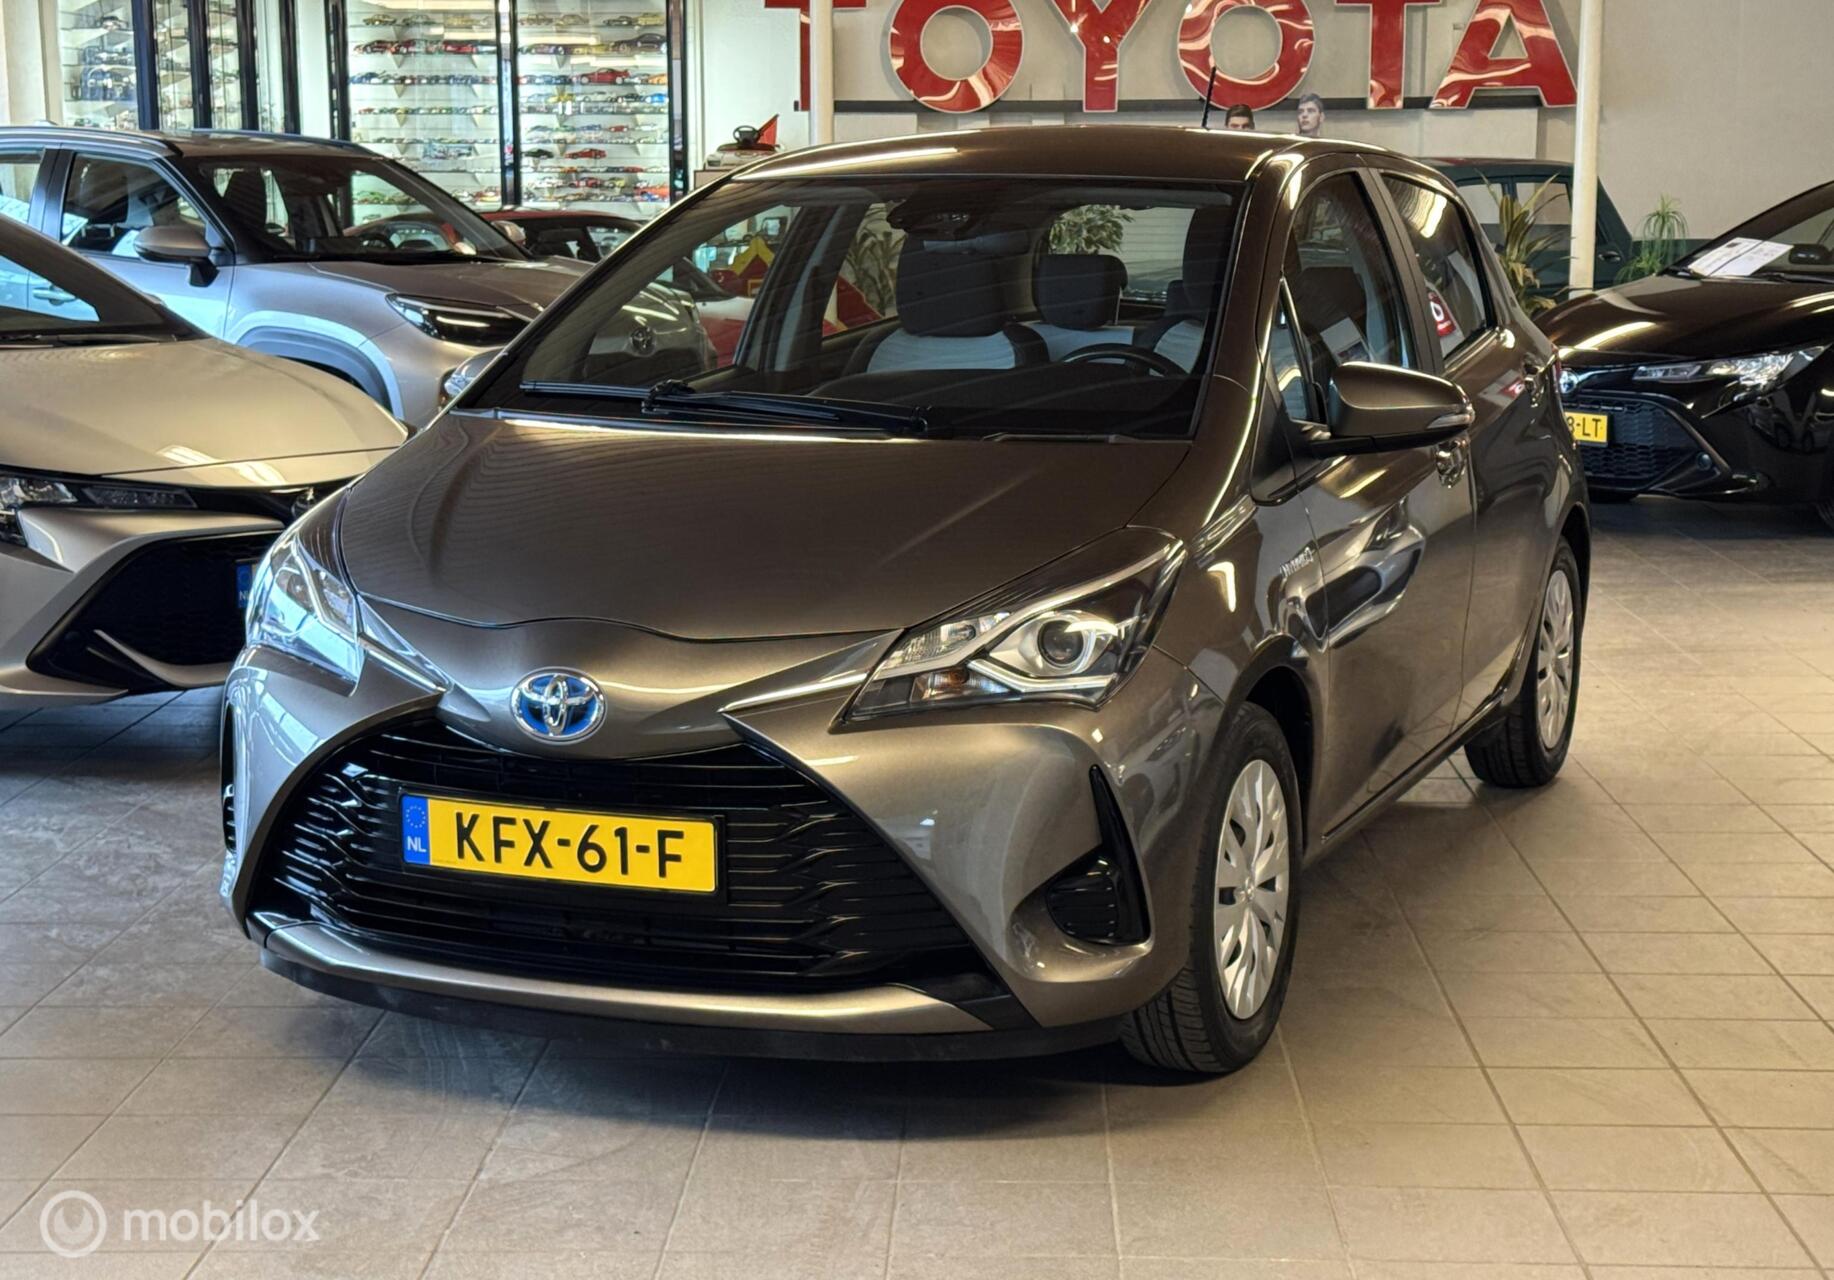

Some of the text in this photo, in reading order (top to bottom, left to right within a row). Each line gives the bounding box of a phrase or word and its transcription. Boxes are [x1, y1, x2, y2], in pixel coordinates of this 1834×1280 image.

[764, 0, 1578, 113] OYOTA
[407, 835, 426, 852] NL
[455, 812, 684, 877] KFX-61-F
